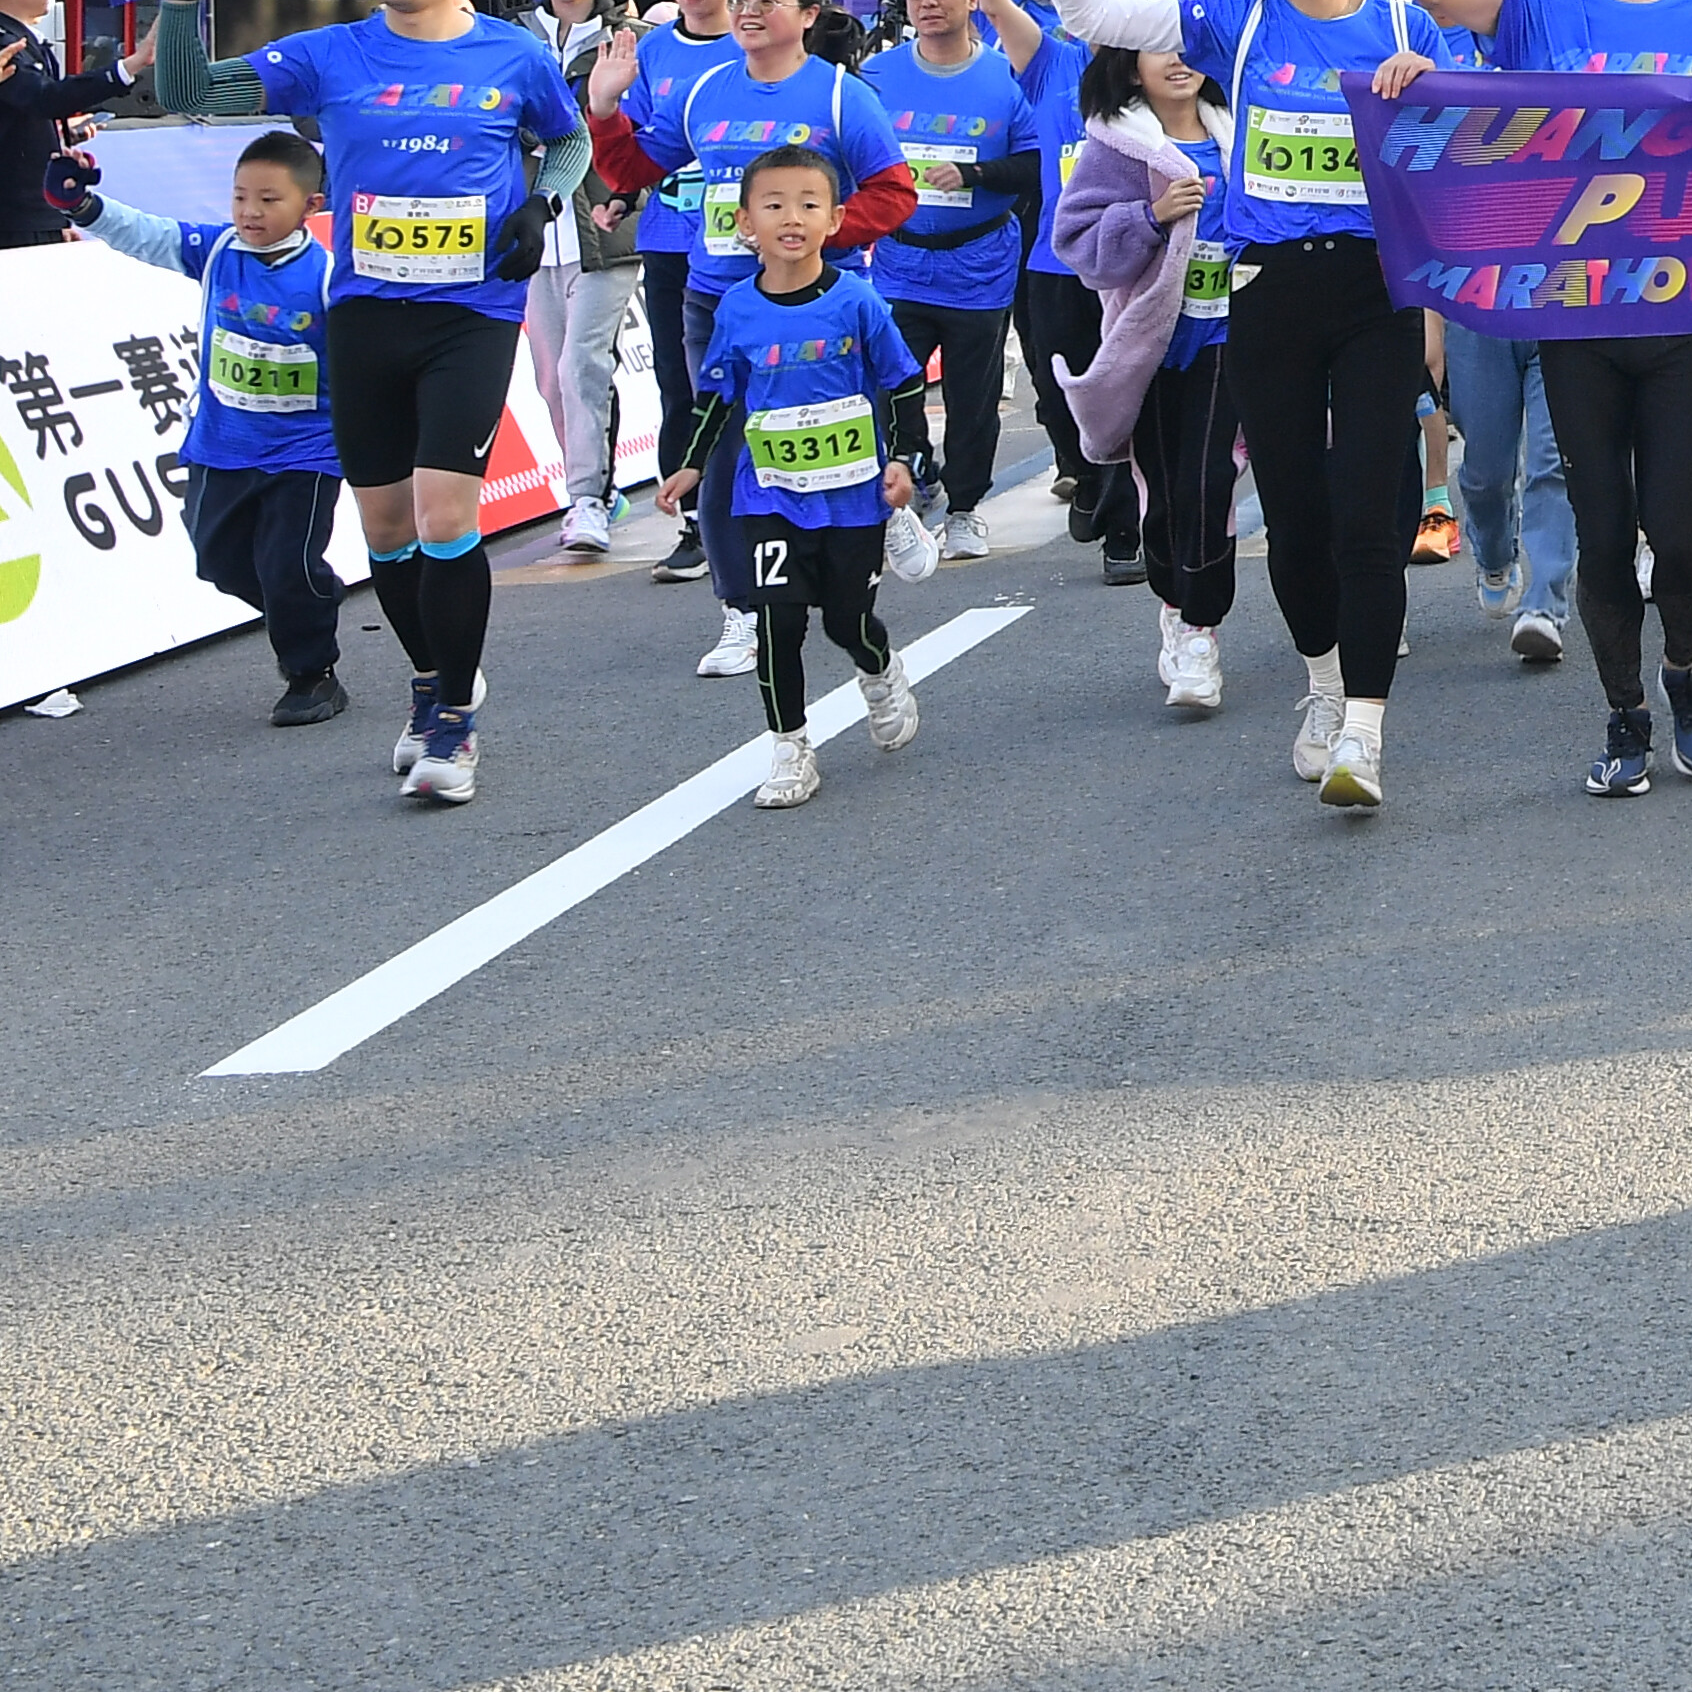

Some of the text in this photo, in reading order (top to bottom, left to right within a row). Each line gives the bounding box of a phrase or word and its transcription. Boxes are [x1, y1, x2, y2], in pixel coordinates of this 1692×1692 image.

[356, 195, 369, 213] B
[364, 219, 474, 250] 40575
[219, 357, 300, 388] 10211
[762, 427, 863, 464] 13312
[754, 539, 789, 588] 12
